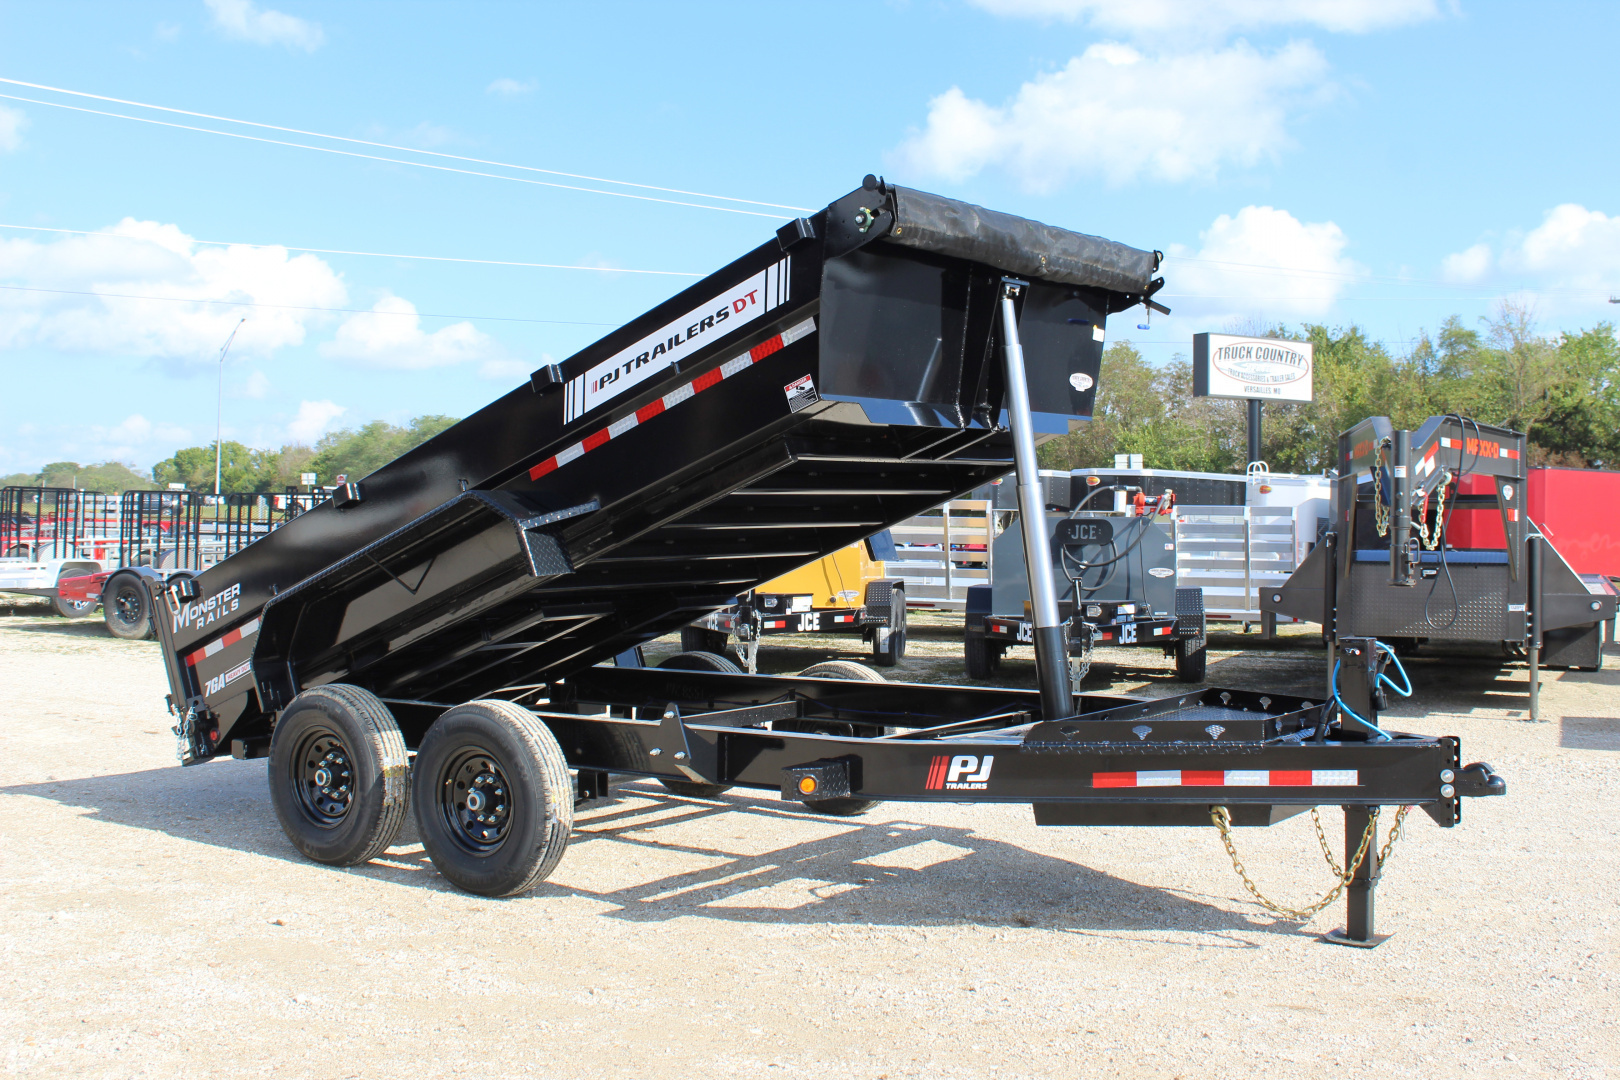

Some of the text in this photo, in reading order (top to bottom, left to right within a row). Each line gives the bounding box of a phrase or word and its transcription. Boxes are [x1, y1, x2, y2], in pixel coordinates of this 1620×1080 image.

[599, 289, 758, 390] PJ TRAILERS DT
[1218, 346, 1304, 366] TRUCK COUNTRY
[1227, 368, 1240, 378] TRUCK
[1270, 374, 1284, 383] TRAILER
[1284, 372, 1296, 381] SALES
[1071, 524, 1097, 540] JCE
[173, 583, 240, 633] MONSTER
[197, 598, 239, 630] RAILS
[797, 612, 820, 632] JCE
[1119, 623, 1138, 644] JCE
[947, 755, 994, 782] PJ
[945, 782, 988, 790] TRAILERS
